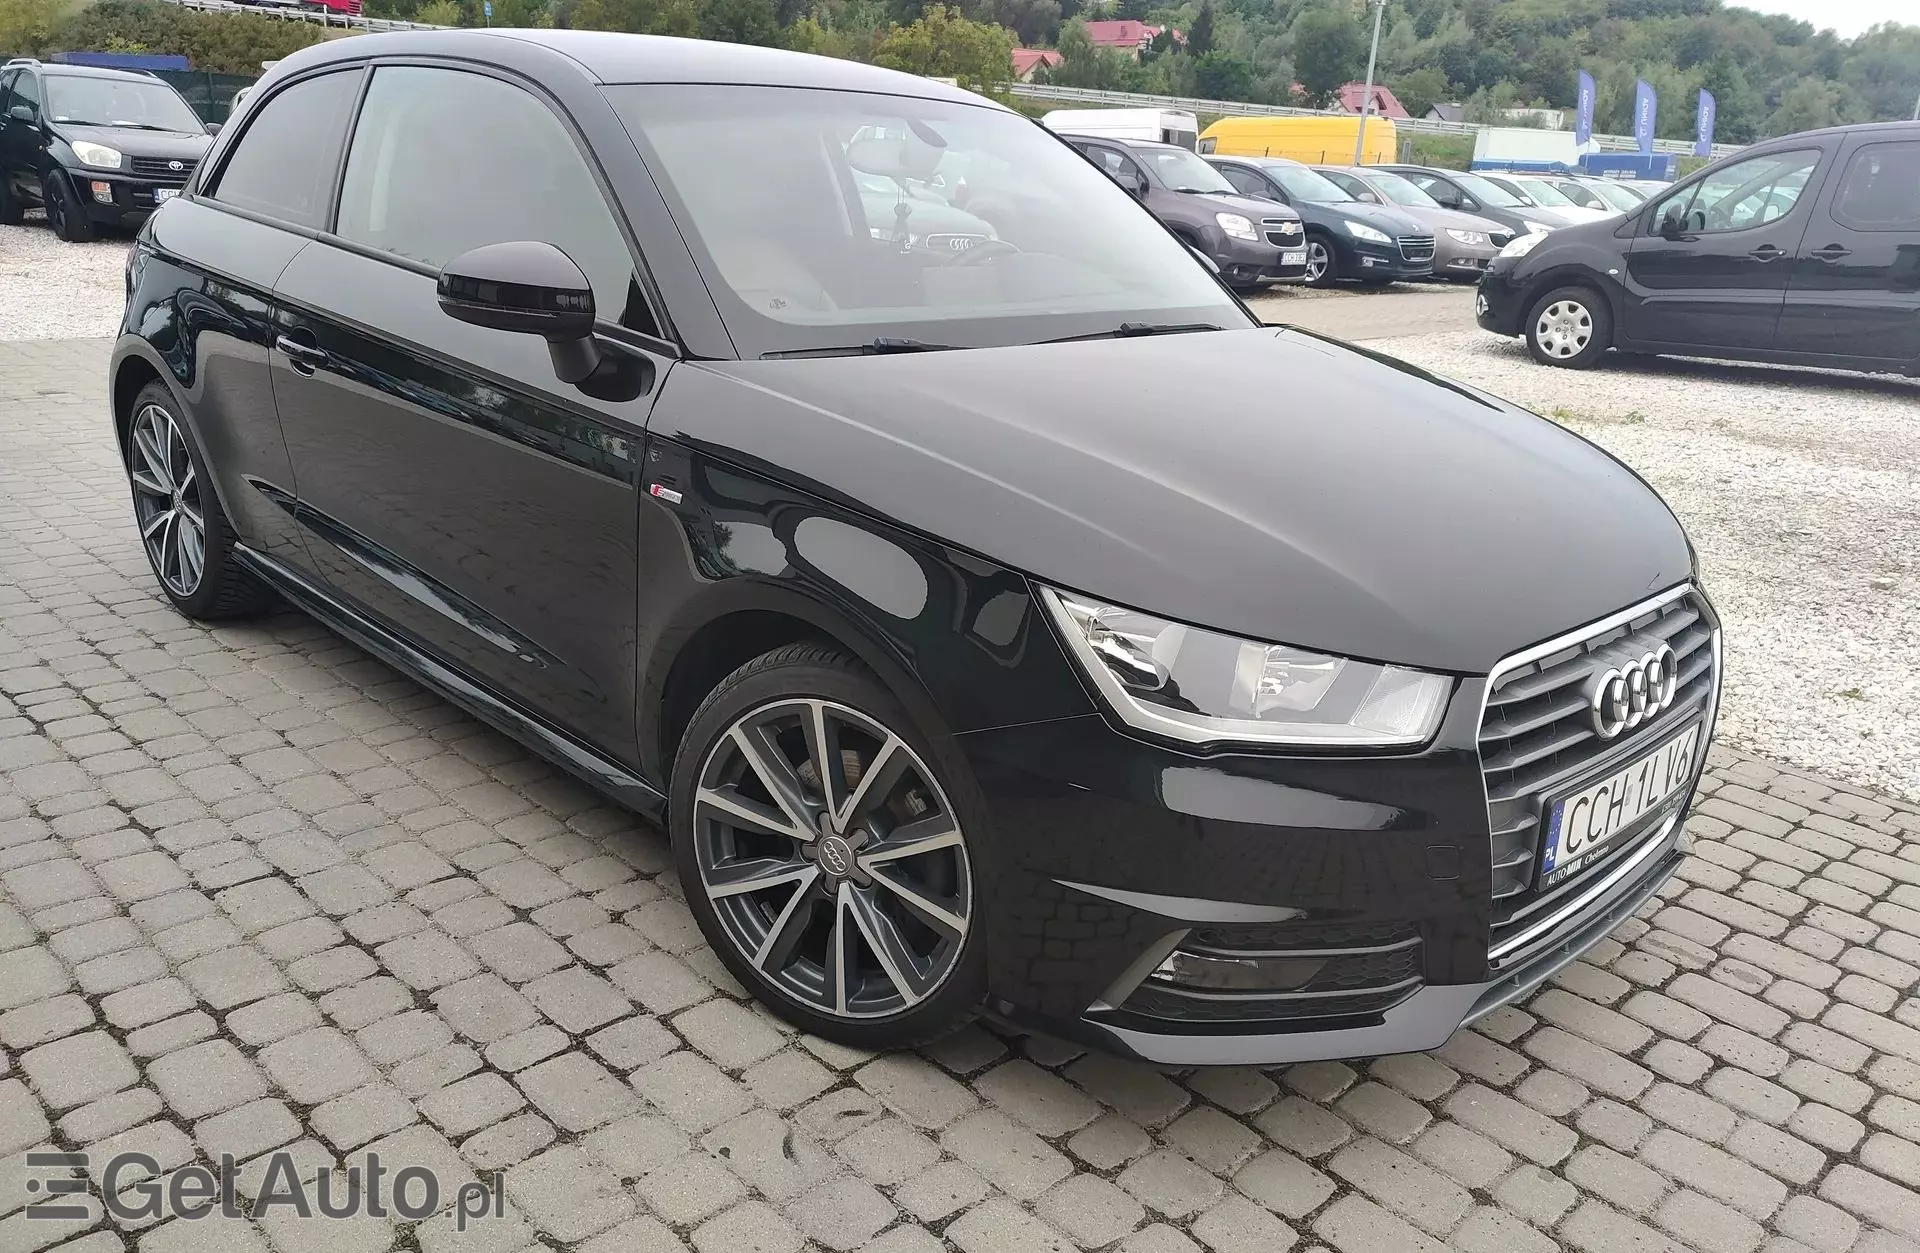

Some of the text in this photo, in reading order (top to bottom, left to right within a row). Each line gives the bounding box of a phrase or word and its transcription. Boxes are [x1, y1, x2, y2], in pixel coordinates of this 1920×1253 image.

[1566, 730, 1694, 854] CCH 1LV6
[1545, 846, 1555, 862] PL
